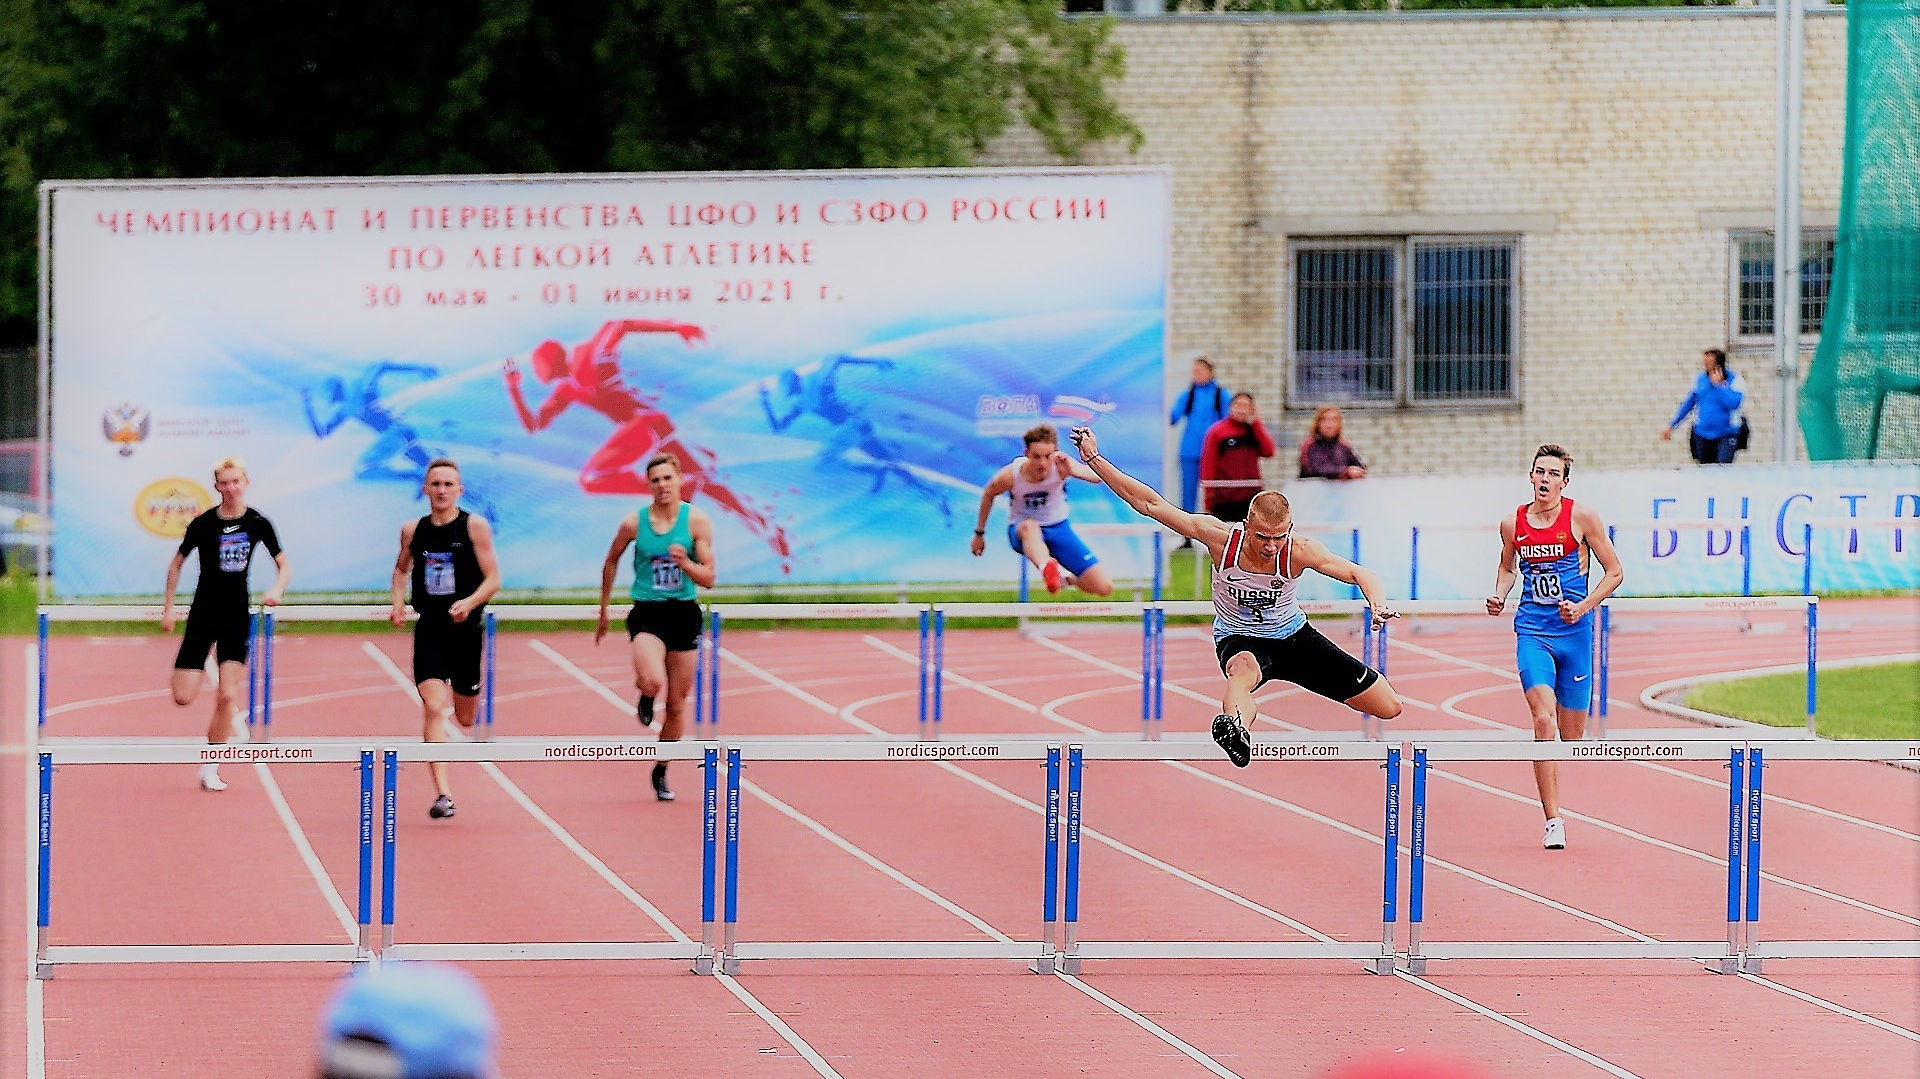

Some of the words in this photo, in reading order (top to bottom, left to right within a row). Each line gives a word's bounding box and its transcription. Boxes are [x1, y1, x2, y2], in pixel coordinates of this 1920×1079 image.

[96, 208, 337, 236] ЧЕМПИОНАТ
[363, 208, 387, 232] И
[410, 204, 645, 230] ПЕРВЕНСТВА
[668, 201, 757, 228] ЦФО
[776, 202, 799, 226] И
[818, 199, 928, 225] СЗФО
[951, 196, 1108, 223] РОССИИ
[388, 245, 446, 271] ПО
[471, 242, 612, 270] ЛЕГКОЙ
[636, 240, 816, 267] АТЛЕТИКЕ
[363, 285, 402, 307] 30
[425, 290, 488, 306] мая
[541, 284, 579, 305] 01
[603, 287, 692, 303] июня
[715, 280, 794, 303] 2021
[819, 284, 845, 301] г.
[1520, 543, 1564, 558] RUSSIA
[1531, 574, 1560, 600] 103
[200, 746, 312, 762] nordicsport.com
[544, 744, 657, 760] nordicsport.com
[887, 743, 999, 760] nordicsport.com
[1251, 743, 1339, 759] dicsport.com
[1572, 743, 1683, 760] nordicsport.com
[1414, 805, 1424, 857] nordicsport.com
[1732, 804, 1741, 856] nordicsport.com
